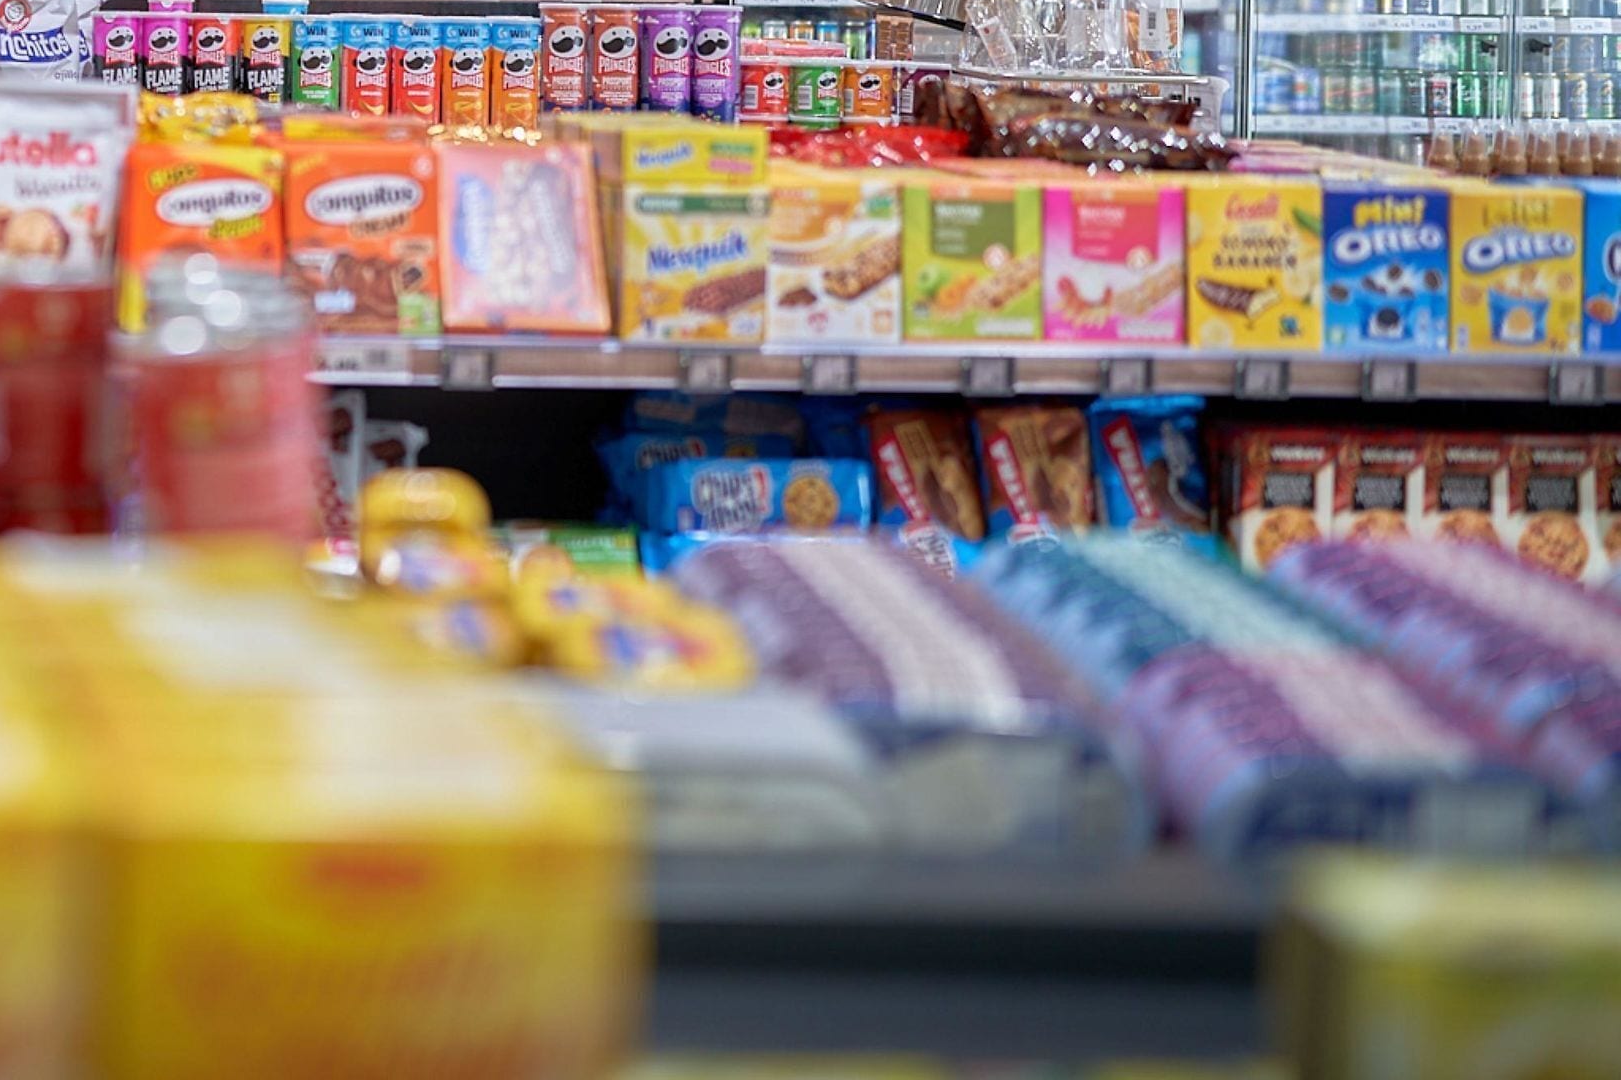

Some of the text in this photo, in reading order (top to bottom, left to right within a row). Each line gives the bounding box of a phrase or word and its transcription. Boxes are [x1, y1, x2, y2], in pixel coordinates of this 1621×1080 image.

[306, 26, 329, 37] WIN
[363, 26, 385, 38] WIN
[409, 26, 431, 37] WIN
[457, 27, 481, 38] WIN
[509, 28, 531, 39] WIN
[598, 55, 636, 75] PRINGLES
[653, 56, 690, 76] PRINGLES
[695, 57, 732, 77] PRINGLES
[102, 67, 138, 85] FLAME
[146, 69, 183, 91] FLAME
[193, 68, 230, 89] FLAME
[247, 69, 285, 91] FLAME
[1353, 196, 1427, 226] mini
[647, 229, 750, 273] Nesquik
[1334, 226, 1444, 263] OREO
[1463, 233, 1577, 271] OREO
